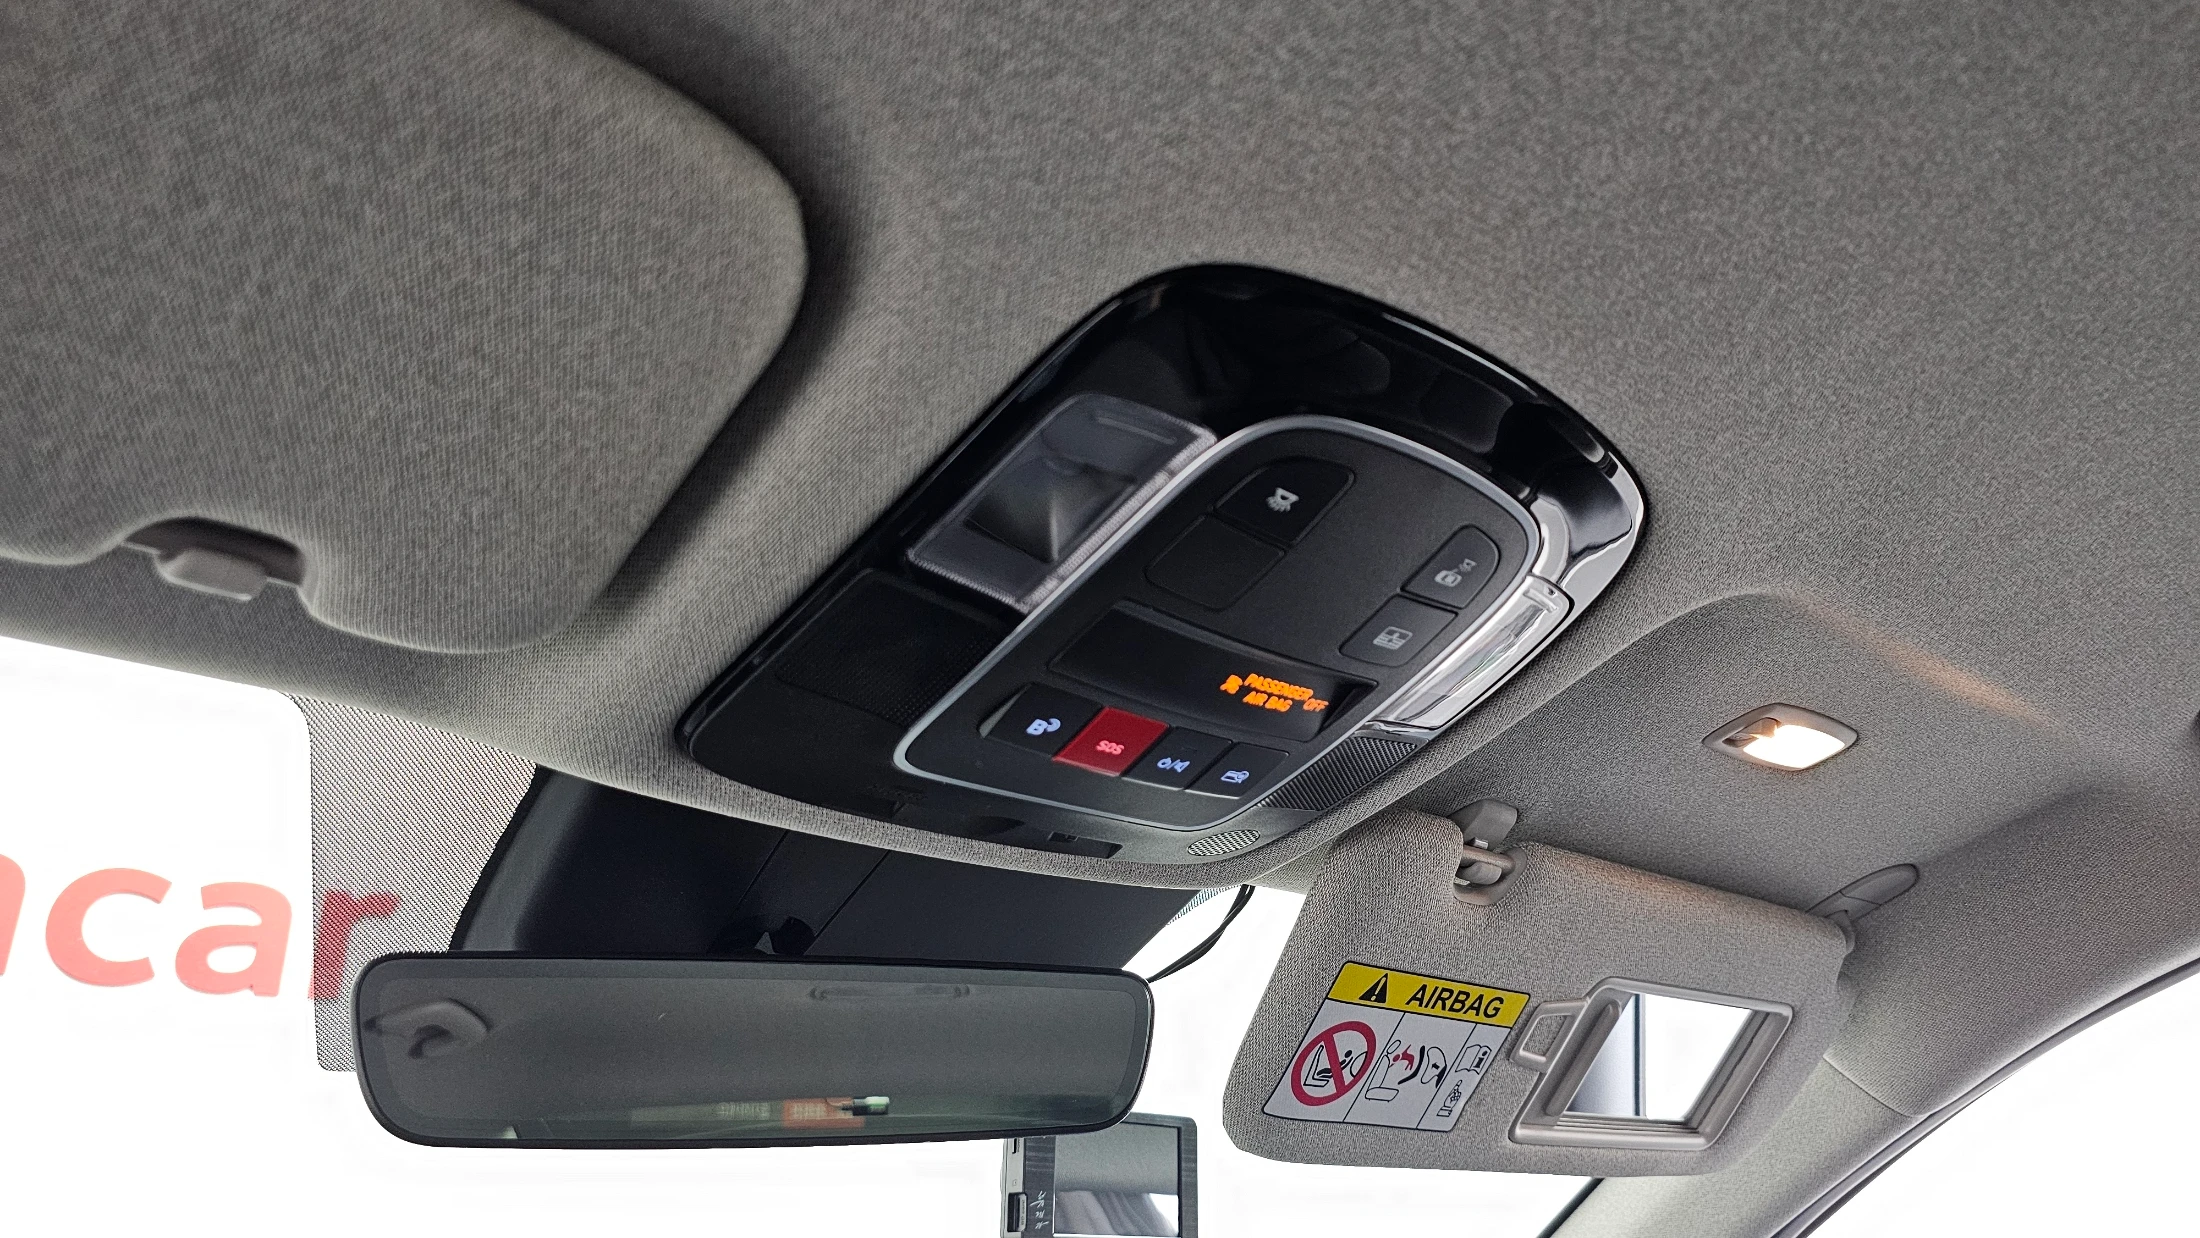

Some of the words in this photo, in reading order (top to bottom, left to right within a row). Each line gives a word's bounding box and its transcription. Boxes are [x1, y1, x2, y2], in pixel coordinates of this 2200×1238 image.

[1244, 673, 1314, 701] PASSENGER
[1242, 691, 1269, 706] AIR
[1264, 695, 1293, 712] BAG
[1303, 698, 1329, 712] OFF
[1096, 740, 1125, 755] SOS
[0, 853, 400, 1001] car
[1405, 984, 1504, 1018] AIRBAG
